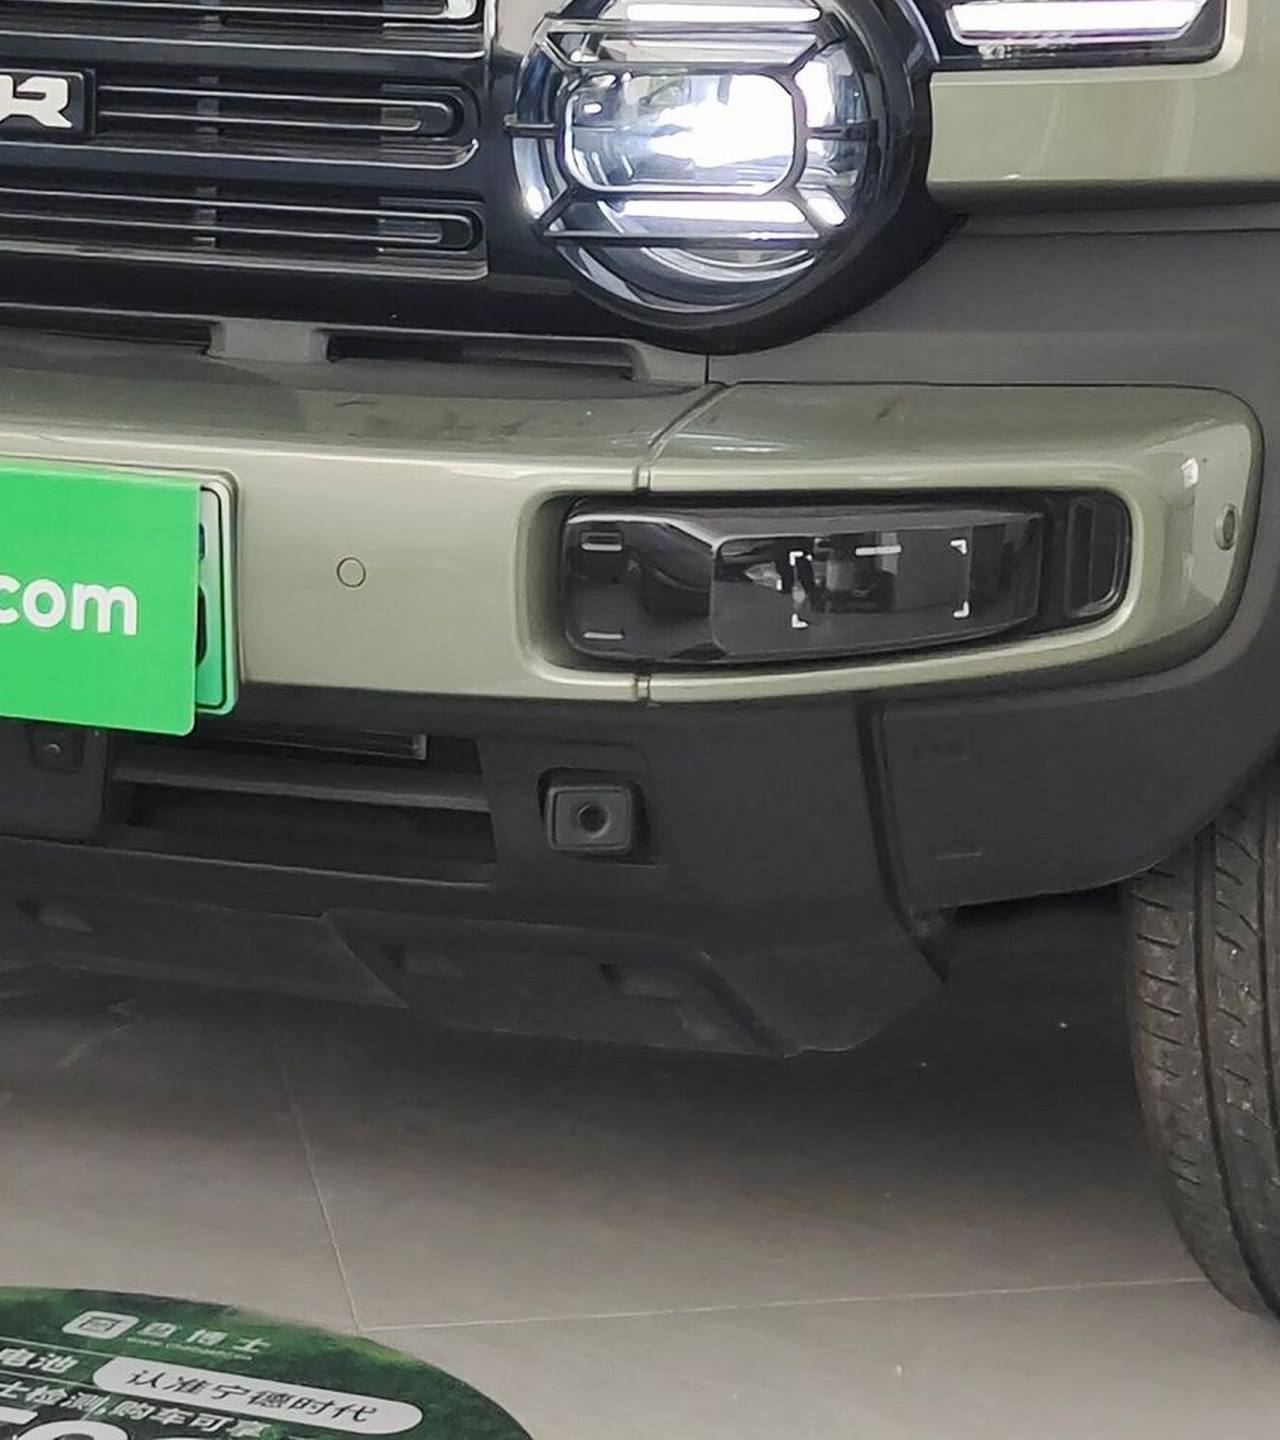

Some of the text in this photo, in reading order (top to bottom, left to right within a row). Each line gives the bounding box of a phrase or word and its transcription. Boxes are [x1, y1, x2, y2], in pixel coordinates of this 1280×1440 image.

[126, 1369, 377, 1422] 认准宁德时代
